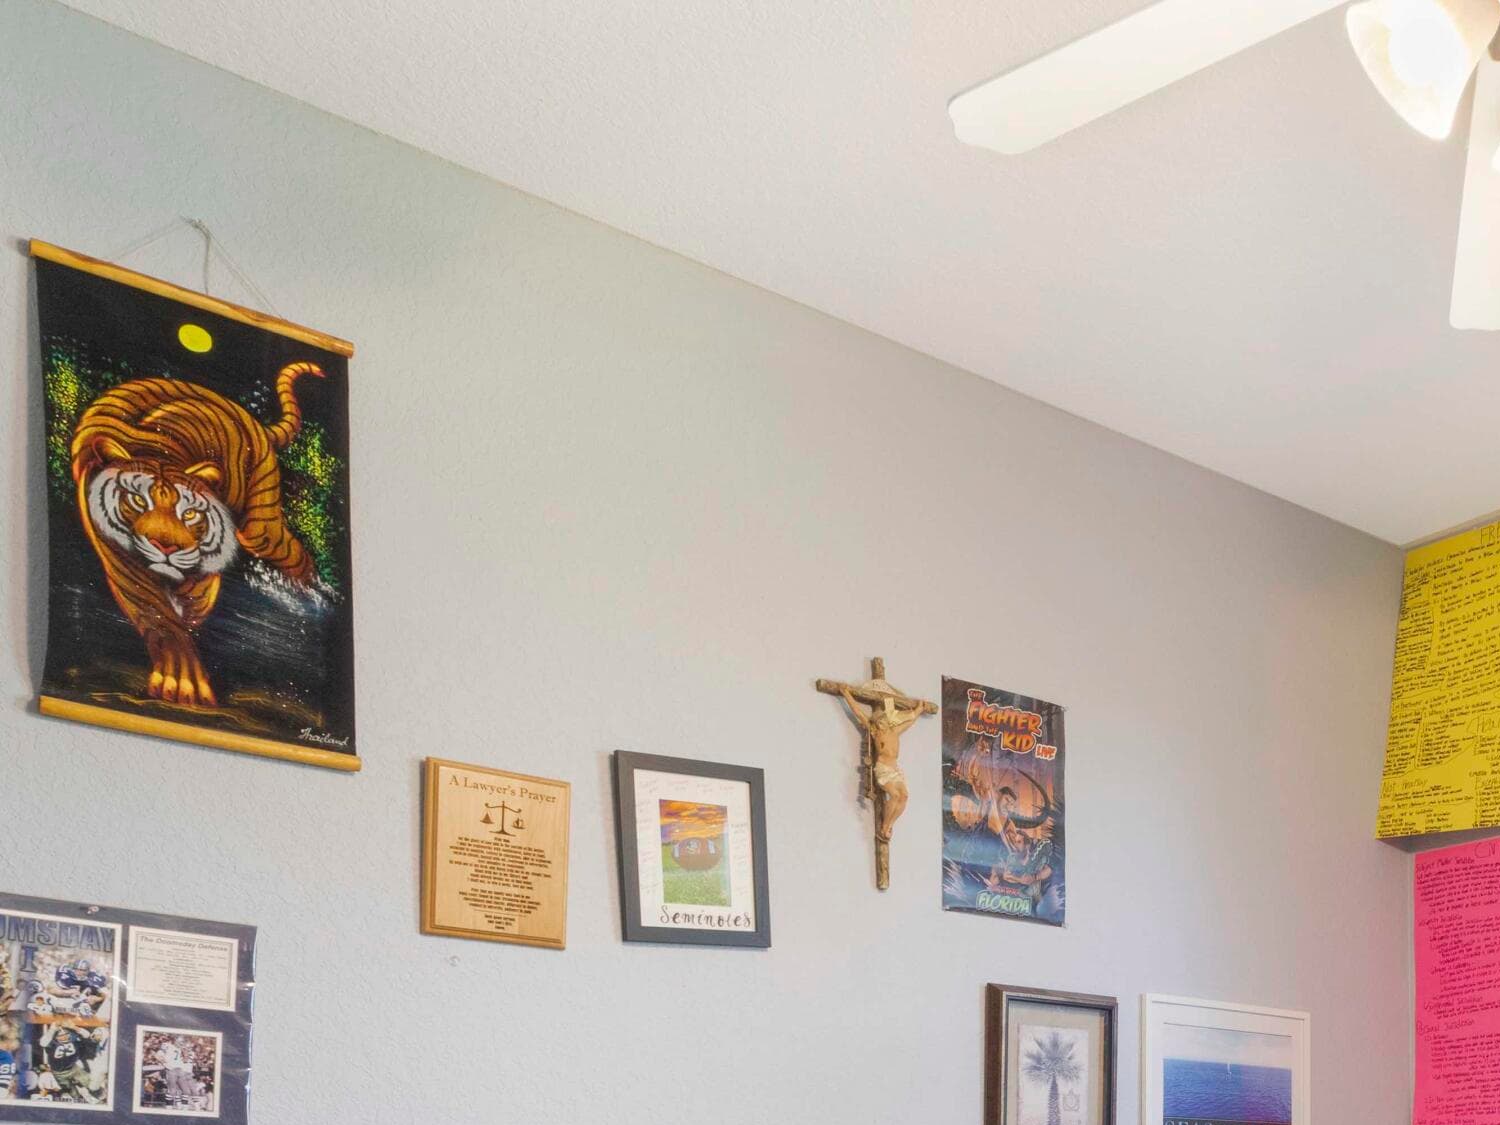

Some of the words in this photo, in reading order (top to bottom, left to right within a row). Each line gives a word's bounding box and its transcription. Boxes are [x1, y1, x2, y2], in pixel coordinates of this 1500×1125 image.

[967, 701, 1042, 735] FIGHTER
[1002, 731, 1035, 753] KID
[449, 774, 460, 787] A
[463, 776, 517, 797] Lawyer's
[519, 786, 558, 804] Prayer
[660, 904, 752, 929] Seminoles
[976, 892, 1032, 916] FLORIDA
[0, 913, 113, 954] MSDAY
